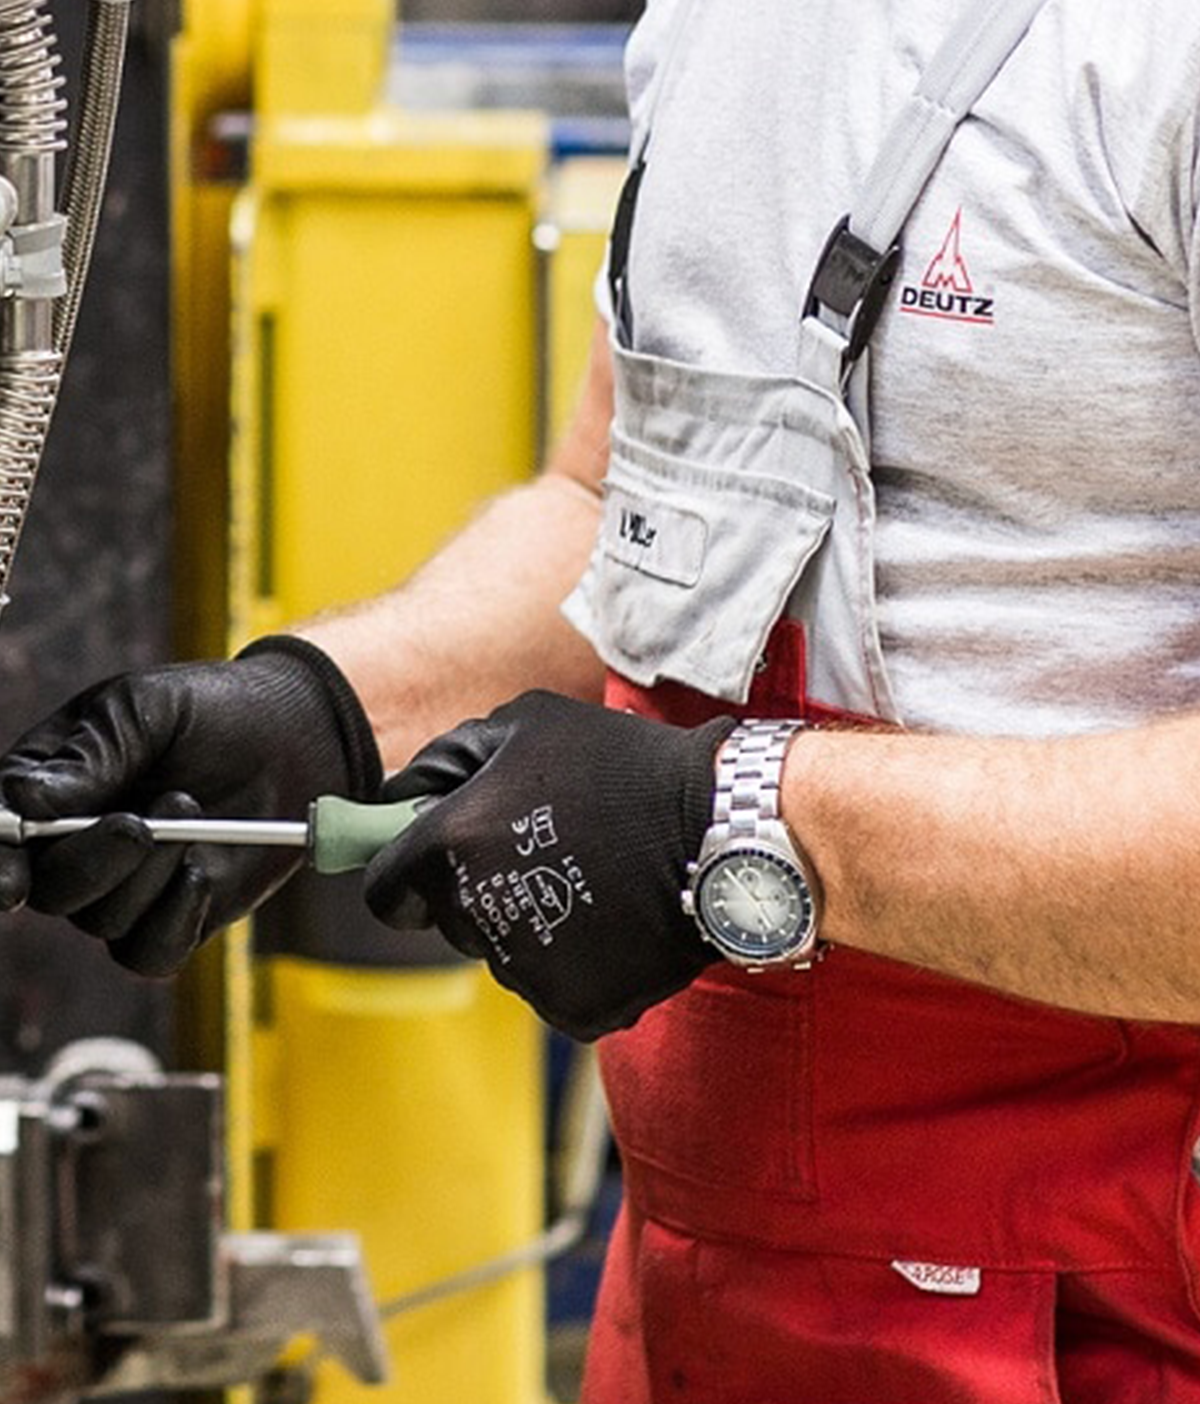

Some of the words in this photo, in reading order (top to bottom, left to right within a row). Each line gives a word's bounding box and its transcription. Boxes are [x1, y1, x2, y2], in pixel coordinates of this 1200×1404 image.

[901, 286, 994, 316] DEUTZ
[511, 816, 534, 856] CE
[507, 870, 532, 910] 388
[528, 915, 553, 946] EN
